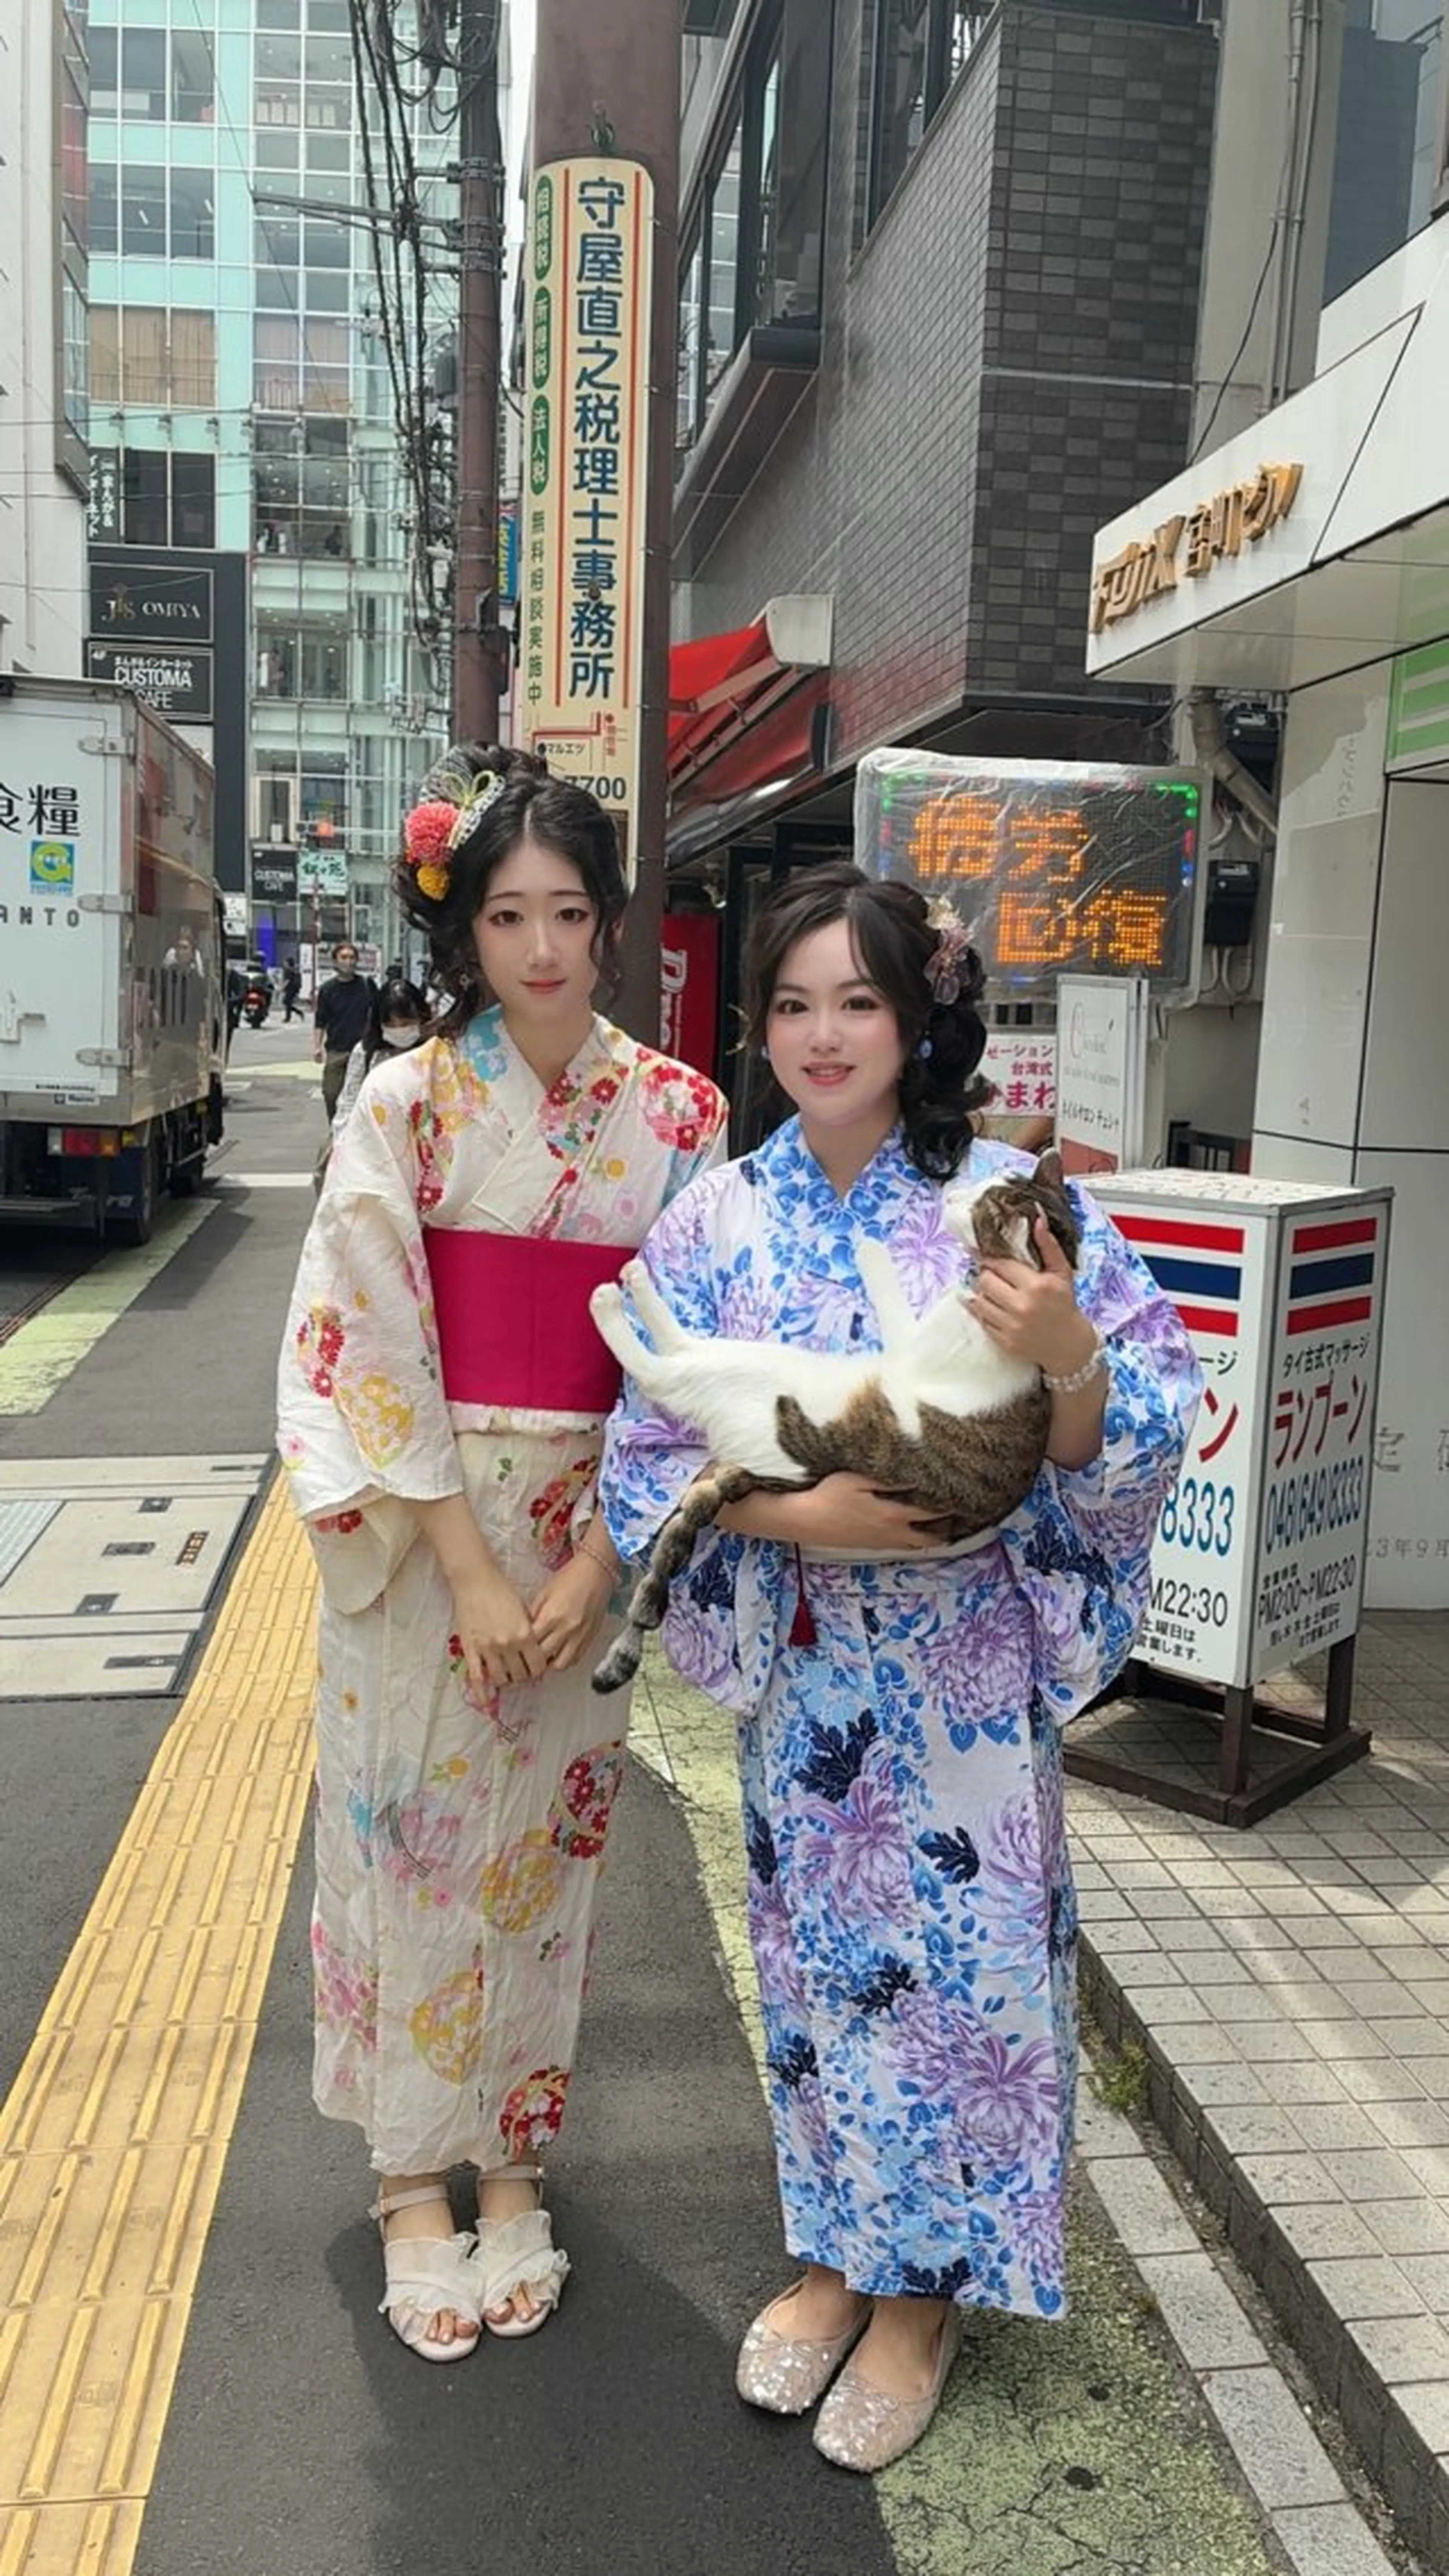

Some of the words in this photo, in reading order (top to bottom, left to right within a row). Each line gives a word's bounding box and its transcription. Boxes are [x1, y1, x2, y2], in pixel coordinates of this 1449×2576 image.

[569, 176, 625, 698] 守屋直之税理士事務所
[115, 667, 193, 687] CUSTOMA
[134, 689, 173, 709] CAFE
[1011, 1061, 1053, 1076] 台湾式
[1283, 1332, 1371, 1378] タイ古式マッサージ
[1198, 1386, 1239, 1464] ン
[1274, 1367, 1367, 1470] ランプーン
[1160, 1477, 1234, 1556] 8333
